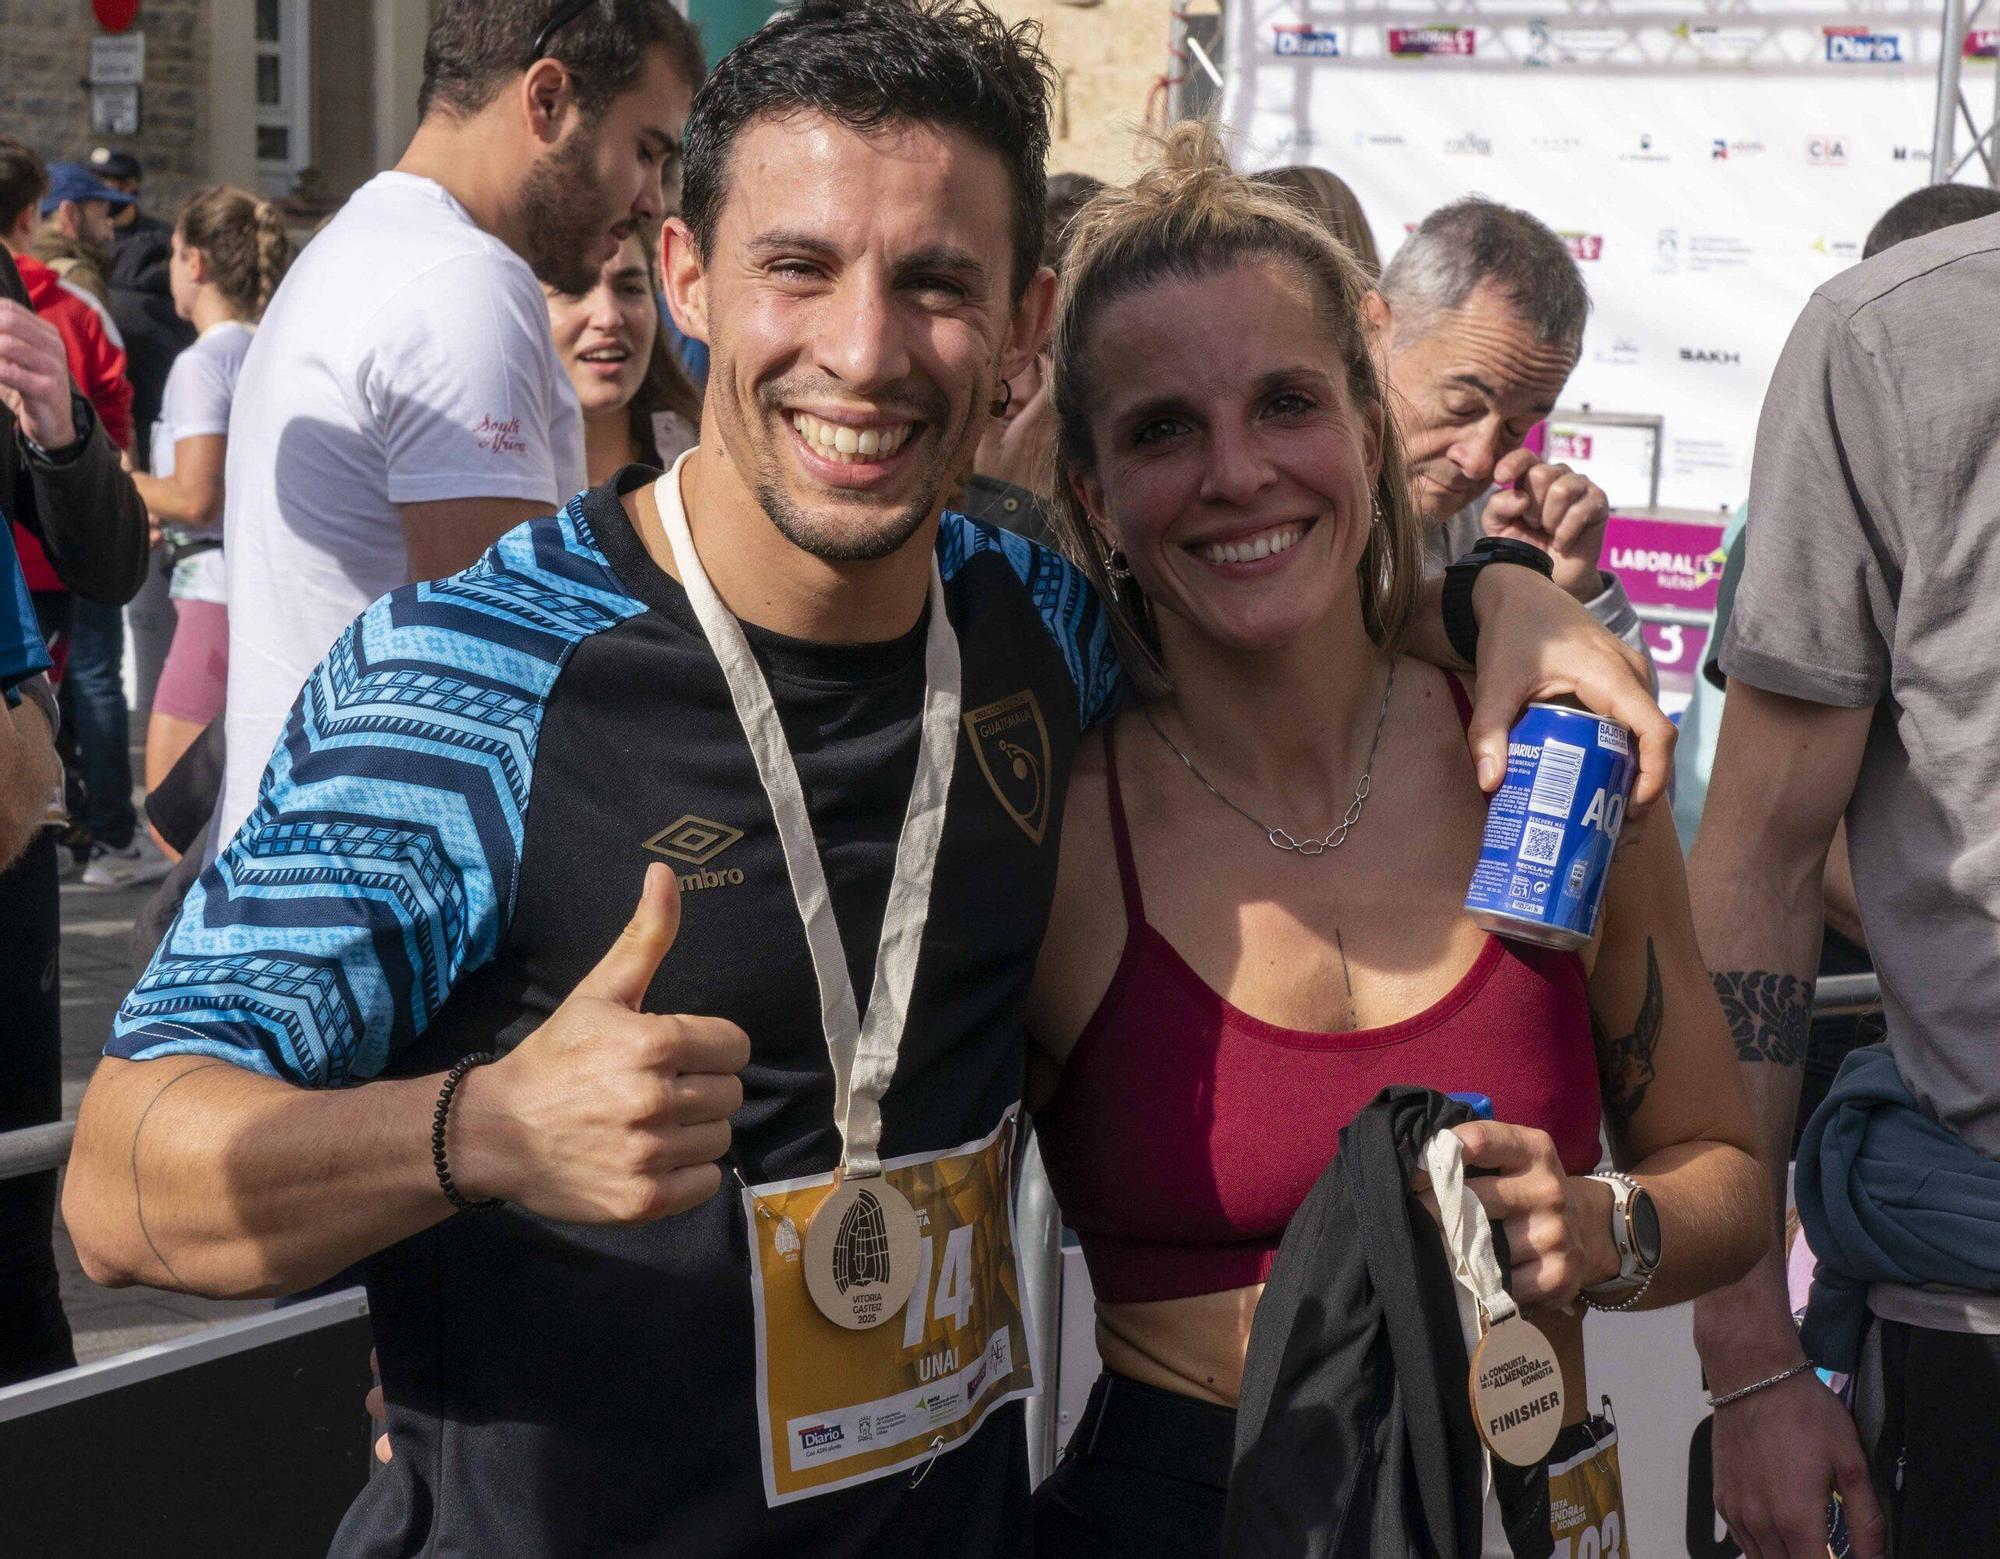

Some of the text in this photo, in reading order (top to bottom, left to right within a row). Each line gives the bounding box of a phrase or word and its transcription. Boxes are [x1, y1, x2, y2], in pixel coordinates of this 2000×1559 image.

[1610, 547, 1695, 576] LABORAL
[1508, 743, 1540, 759] QUARIUS
[678, 867, 745, 892] mbro
[852, 1293, 883, 1305] VITORIA
[852, 1303, 883, 1315] GASTEIZ
[857, 1313, 877, 1325] 2025
[920, 1346, 959, 1382] UNAI
[1479, 1355, 1527, 1383] LA CONQUISTA
[1494, 1359, 1542, 1390] ALMENDRA
[1489, 1391, 1560, 1436] FINISHER
[805, 1429, 840, 1447] Diario
[1551, 1504, 1579, 1523] ENDRA
